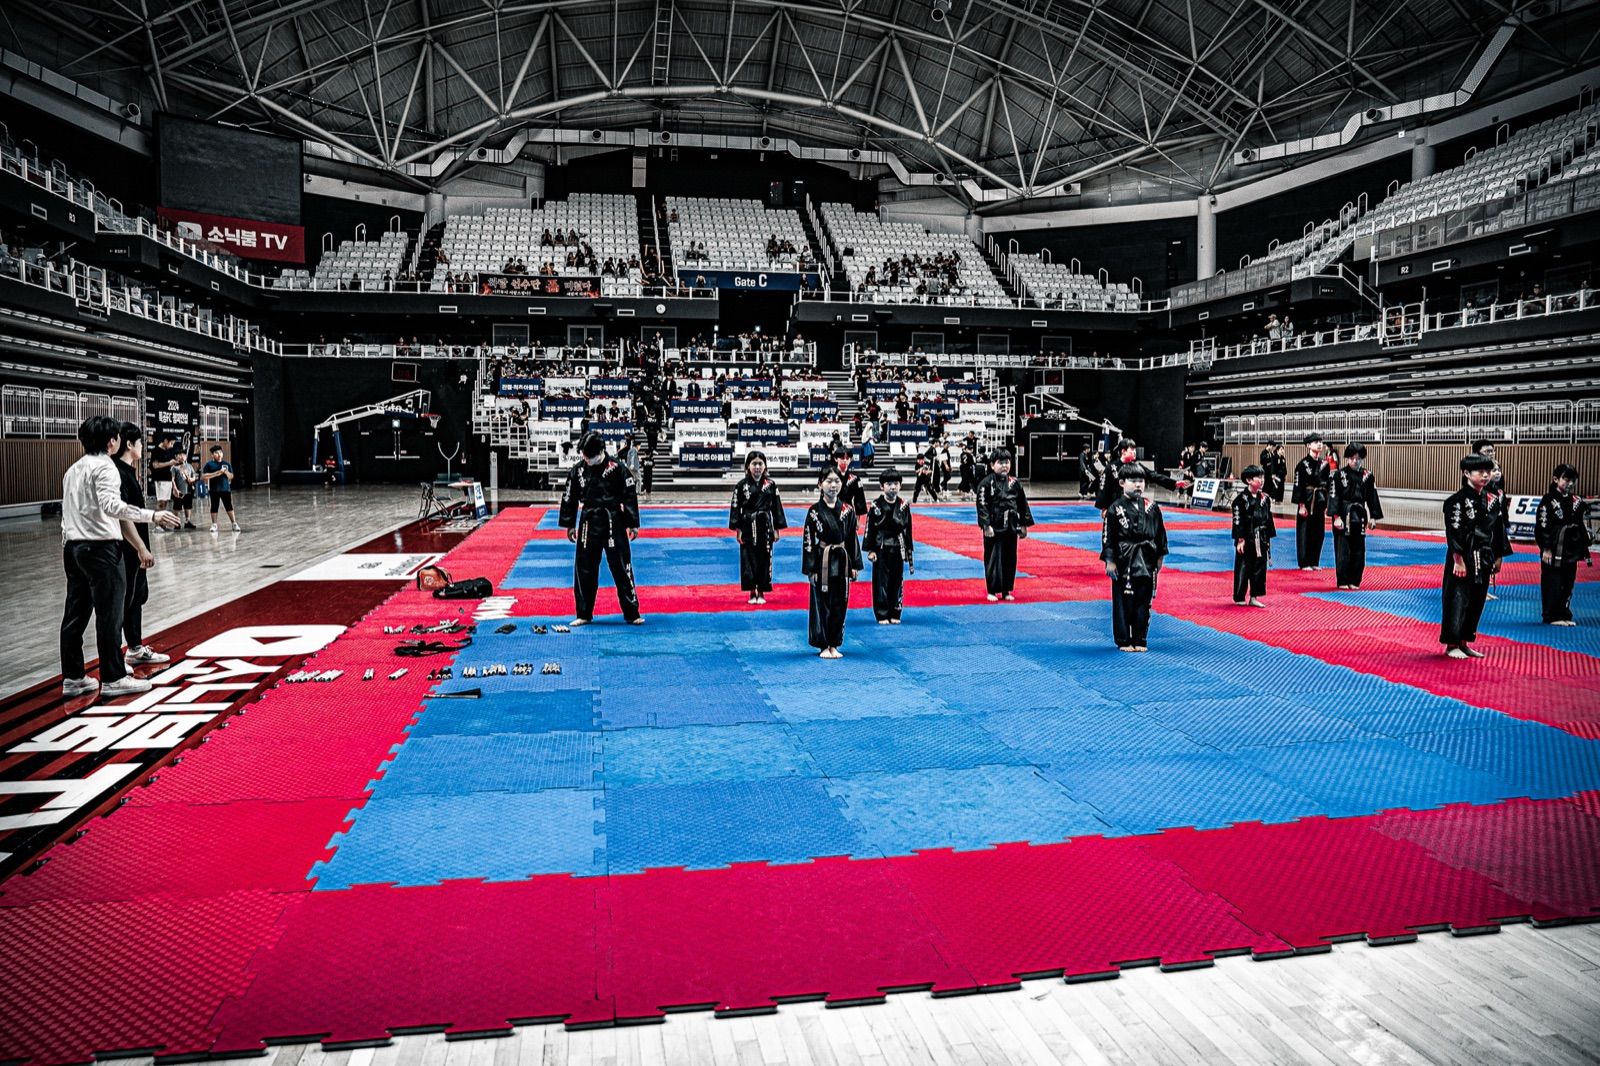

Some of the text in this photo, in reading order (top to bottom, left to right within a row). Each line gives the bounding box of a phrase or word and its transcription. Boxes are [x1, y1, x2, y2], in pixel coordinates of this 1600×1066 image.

[207, 226, 288, 250] 소닉붐 TV
[1400, 265, 1409, 274] R2
[511, 277, 541, 290] 선수단
[734, 274, 767, 287] Gate C
[167, 400, 180, 411] 2024
